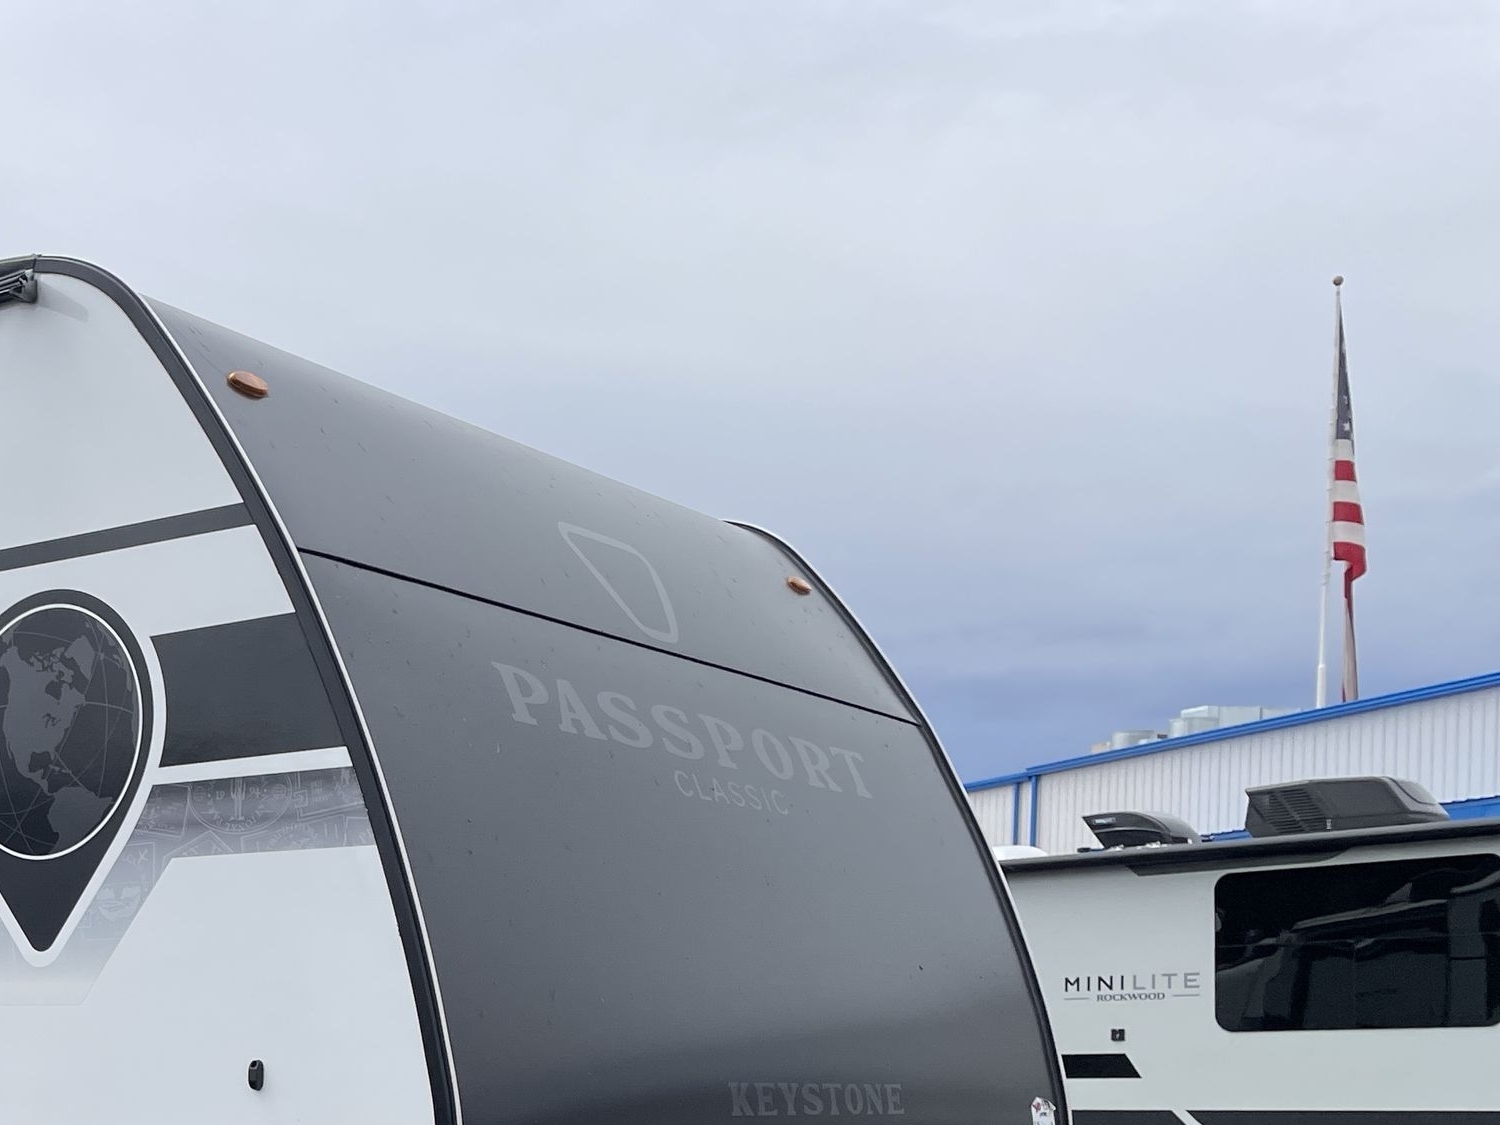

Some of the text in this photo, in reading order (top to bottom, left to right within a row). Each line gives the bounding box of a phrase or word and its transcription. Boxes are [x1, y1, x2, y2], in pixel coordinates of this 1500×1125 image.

[491, 661, 873, 799] PASSPORT
[674, 770, 789, 816] CLASSIC
[1097, 992, 1165, 1002] ROCKWOOD
[728, 1081, 906, 1117] KEYSTONE
